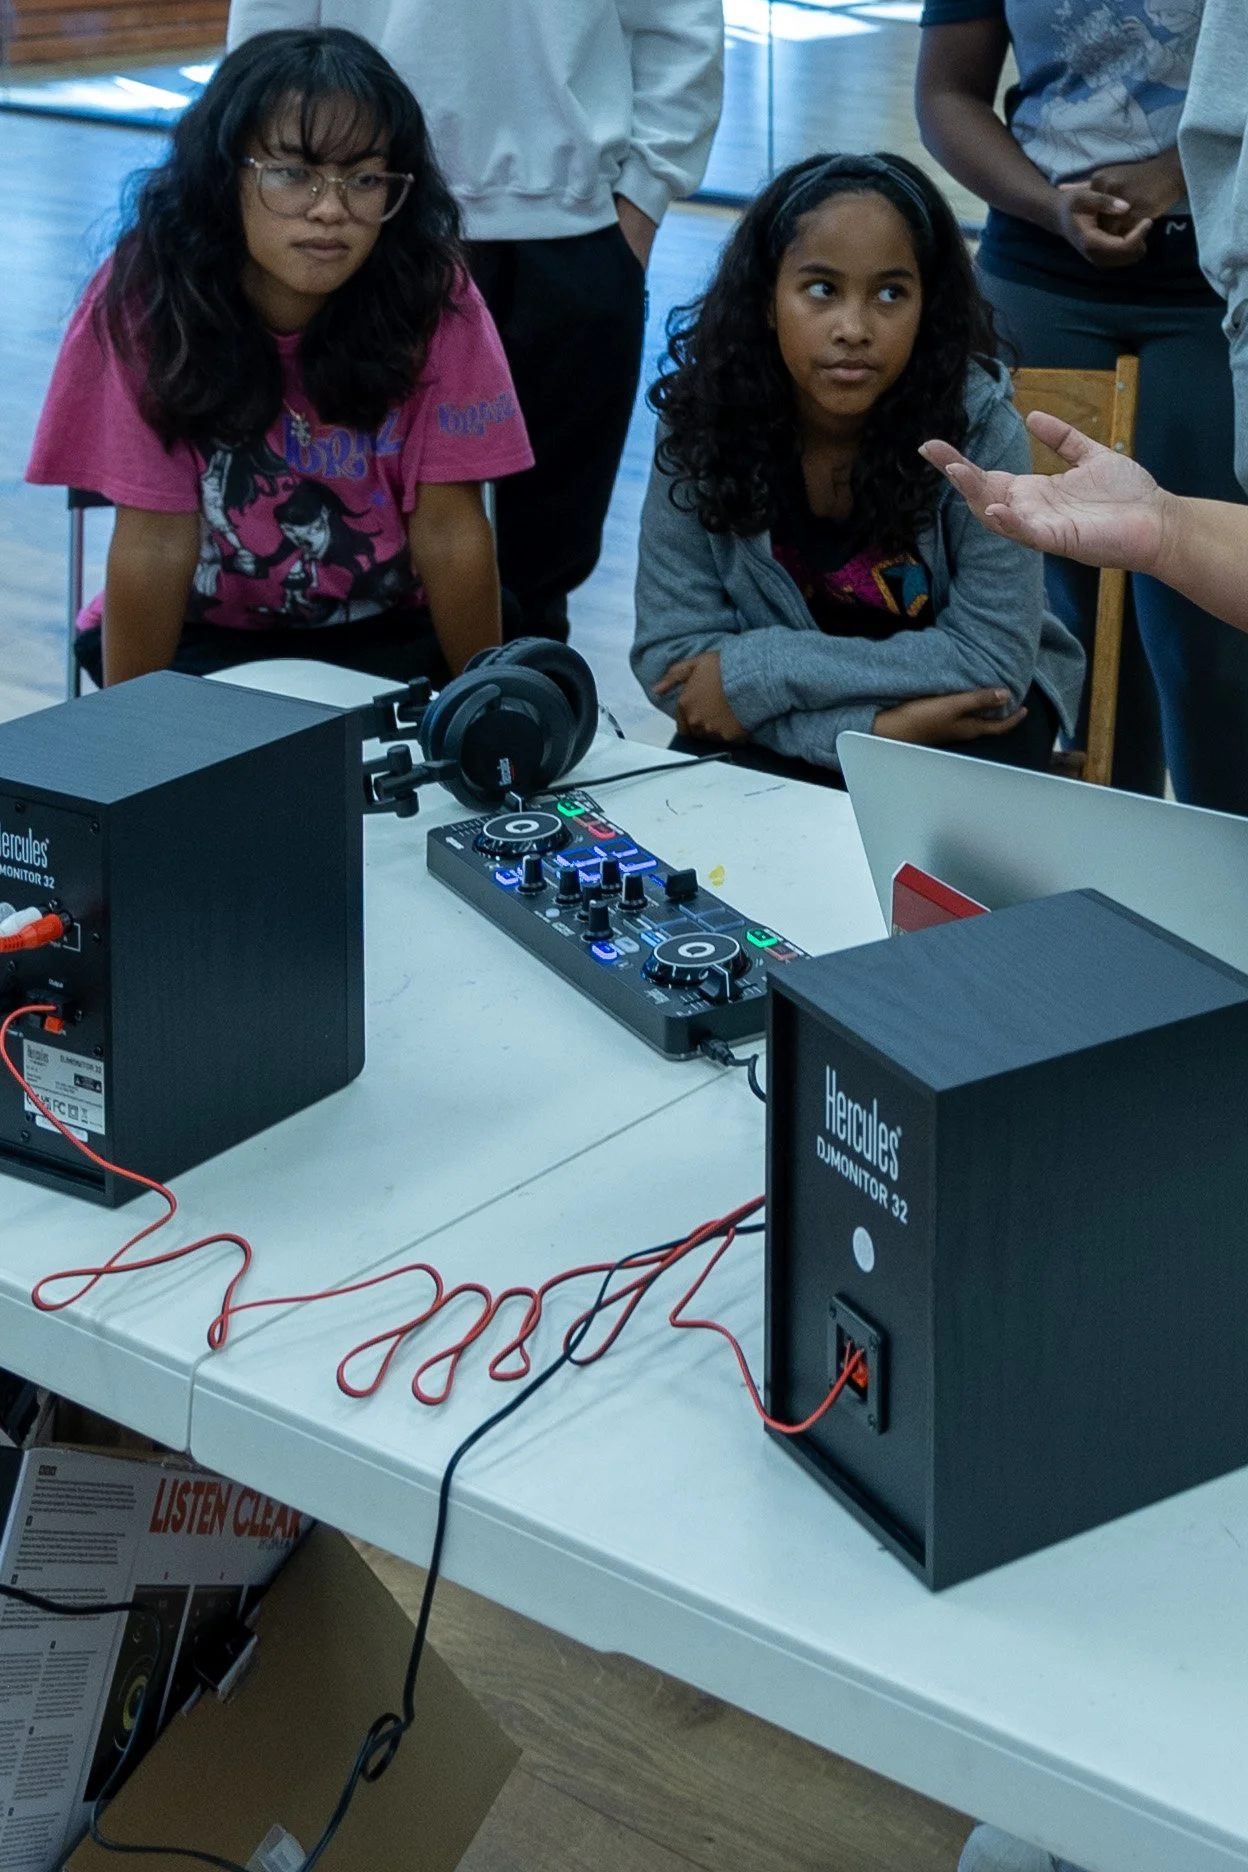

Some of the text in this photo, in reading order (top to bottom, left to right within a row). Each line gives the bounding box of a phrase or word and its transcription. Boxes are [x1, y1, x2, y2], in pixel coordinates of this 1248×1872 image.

[0, 822, 48, 869] ercules
[43, 875, 55, 889] 32
[826, 1065, 899, 1181] Hercules
[817, 1135, 908, 1224] DJMONITOR 32
[149, 1478, 233, 1534] LISTEN
